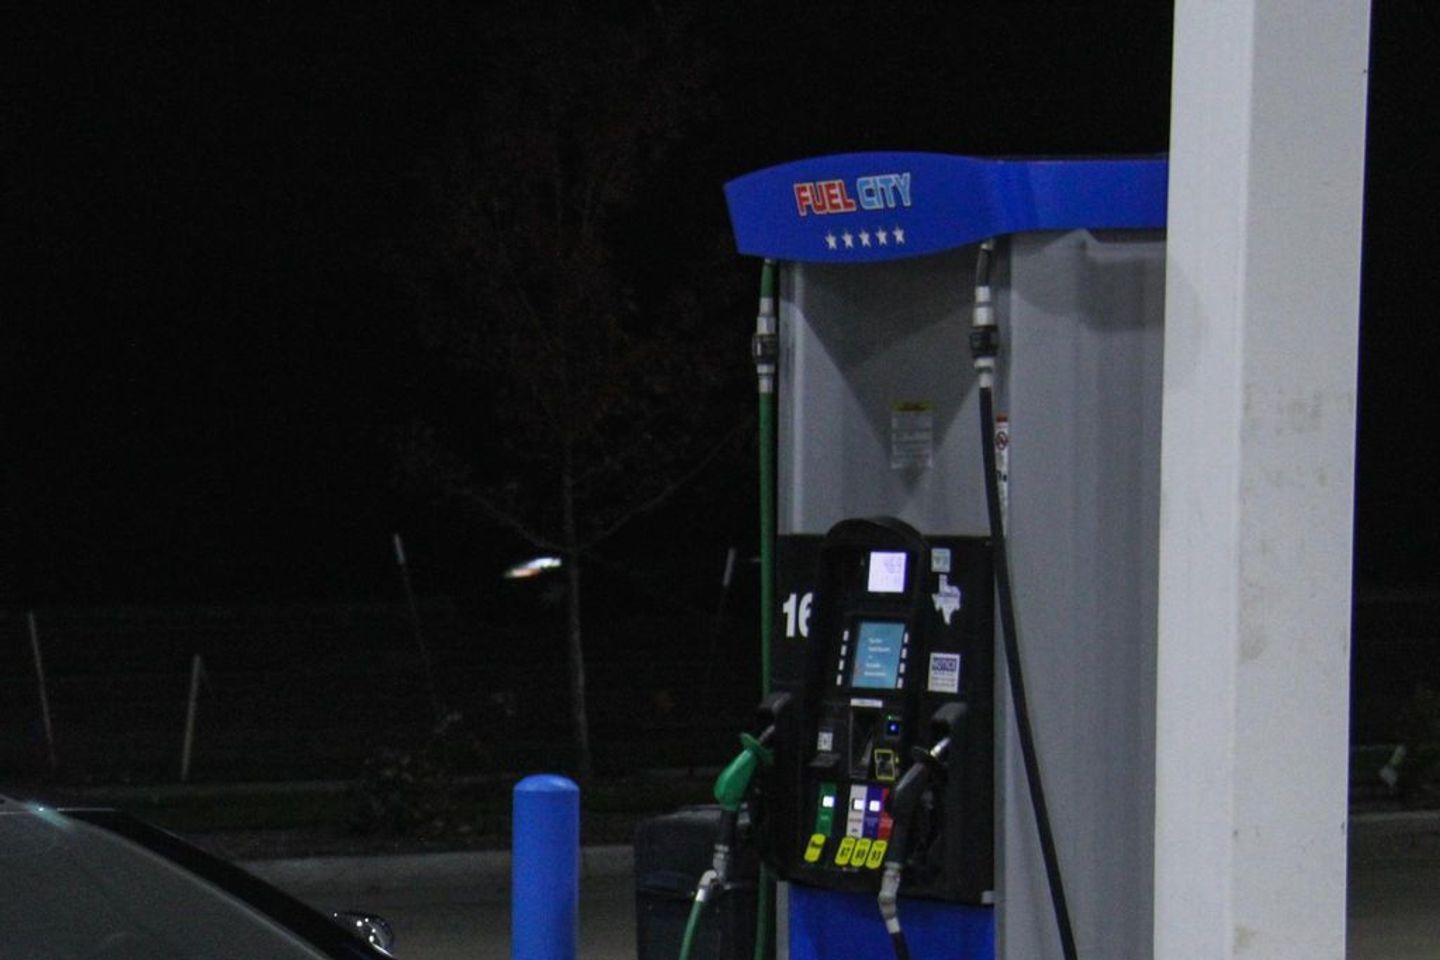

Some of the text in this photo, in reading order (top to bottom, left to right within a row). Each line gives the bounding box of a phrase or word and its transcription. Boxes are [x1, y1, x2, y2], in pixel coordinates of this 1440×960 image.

[793, 172, 912, 216] FUEL CITY
[782, 592, 813, 638] 16
